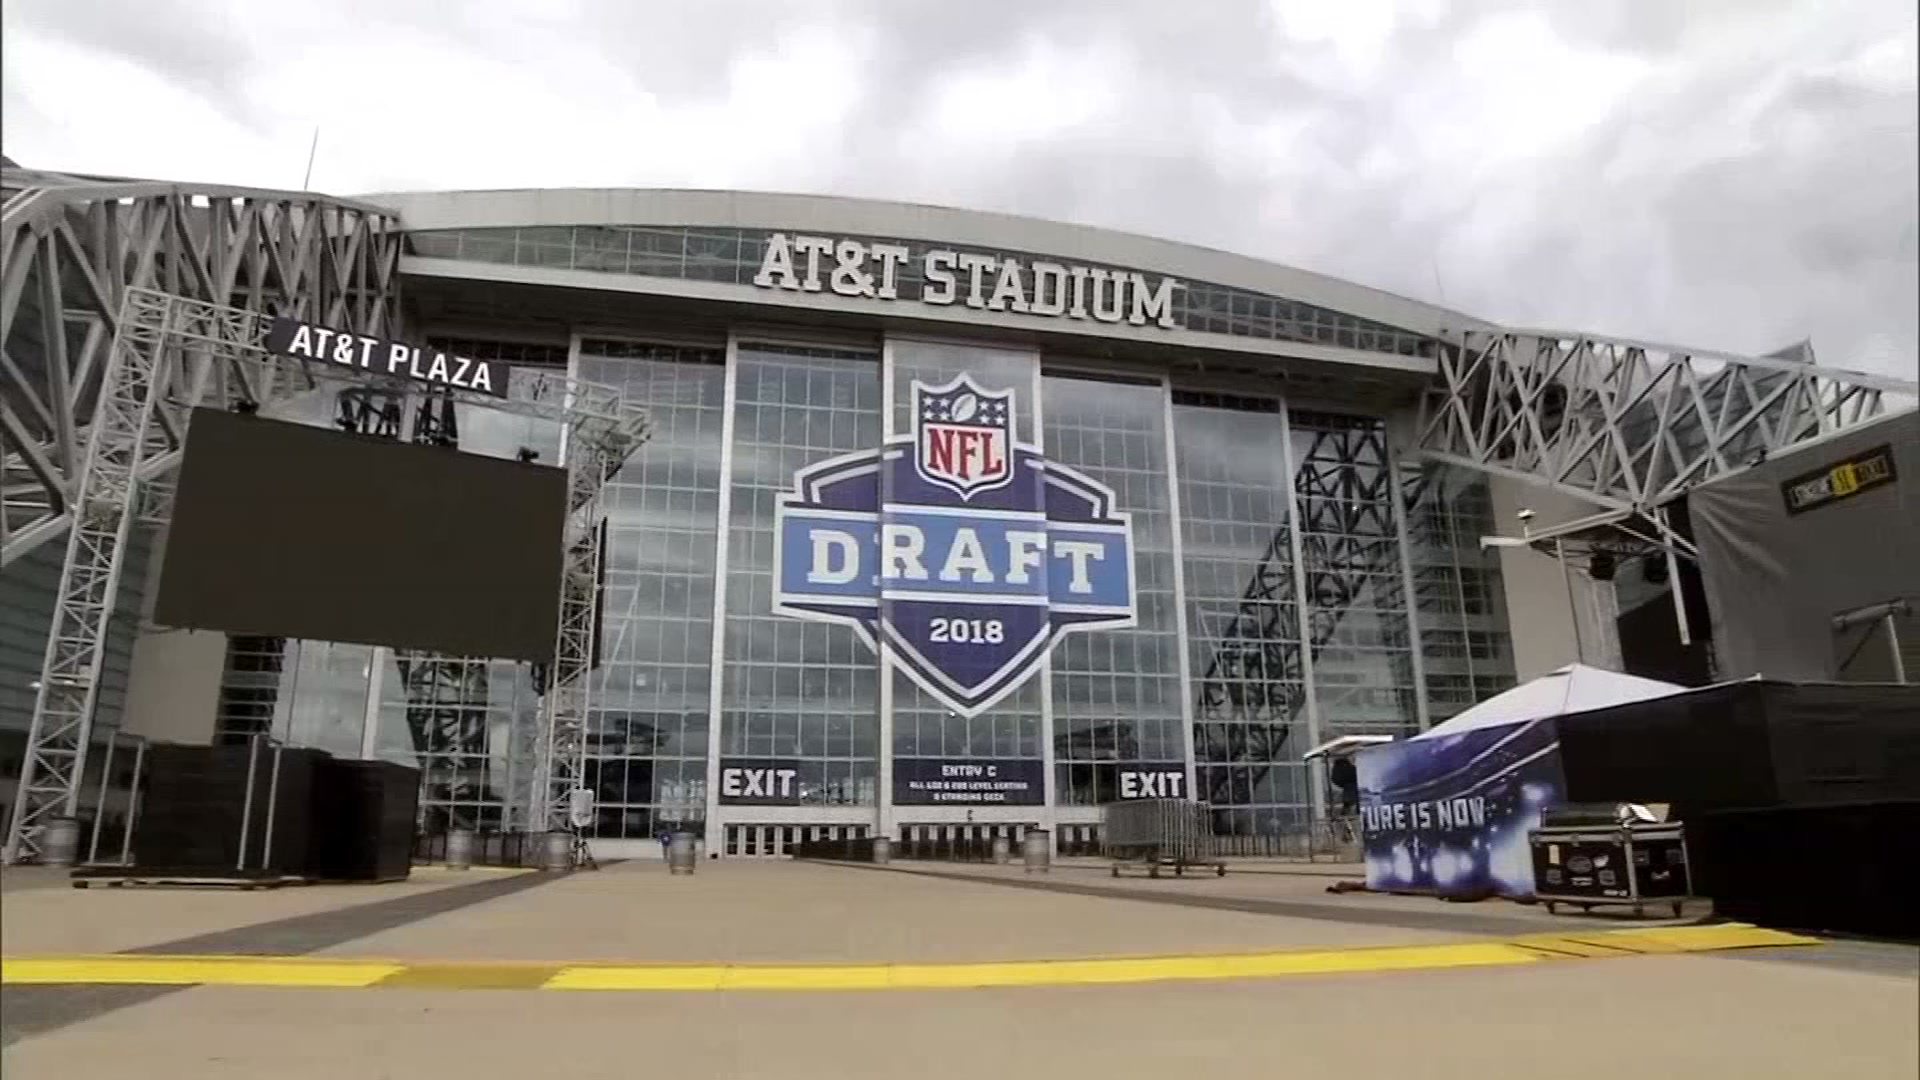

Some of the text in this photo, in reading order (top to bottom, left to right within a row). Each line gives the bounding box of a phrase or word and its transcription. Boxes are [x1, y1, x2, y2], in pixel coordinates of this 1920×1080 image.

[754, 232, 1178, 329] AT&T STADIUM
[288, 324, 492, 392] AT&T PLAZA
[928, 427, 1003, 481] NFL
[807, 524, 1105, 594] DRAFT
[930, 618, 1004, 644] 2018
[722, 767, 796, 797] EXIT
[941, 764, 997, 777] ENTRY C
[1120, 771, 1184, 800] EXIT
[1410, 802, 1431, 829] IS
[1437, 797, 1485, 831] NOW
